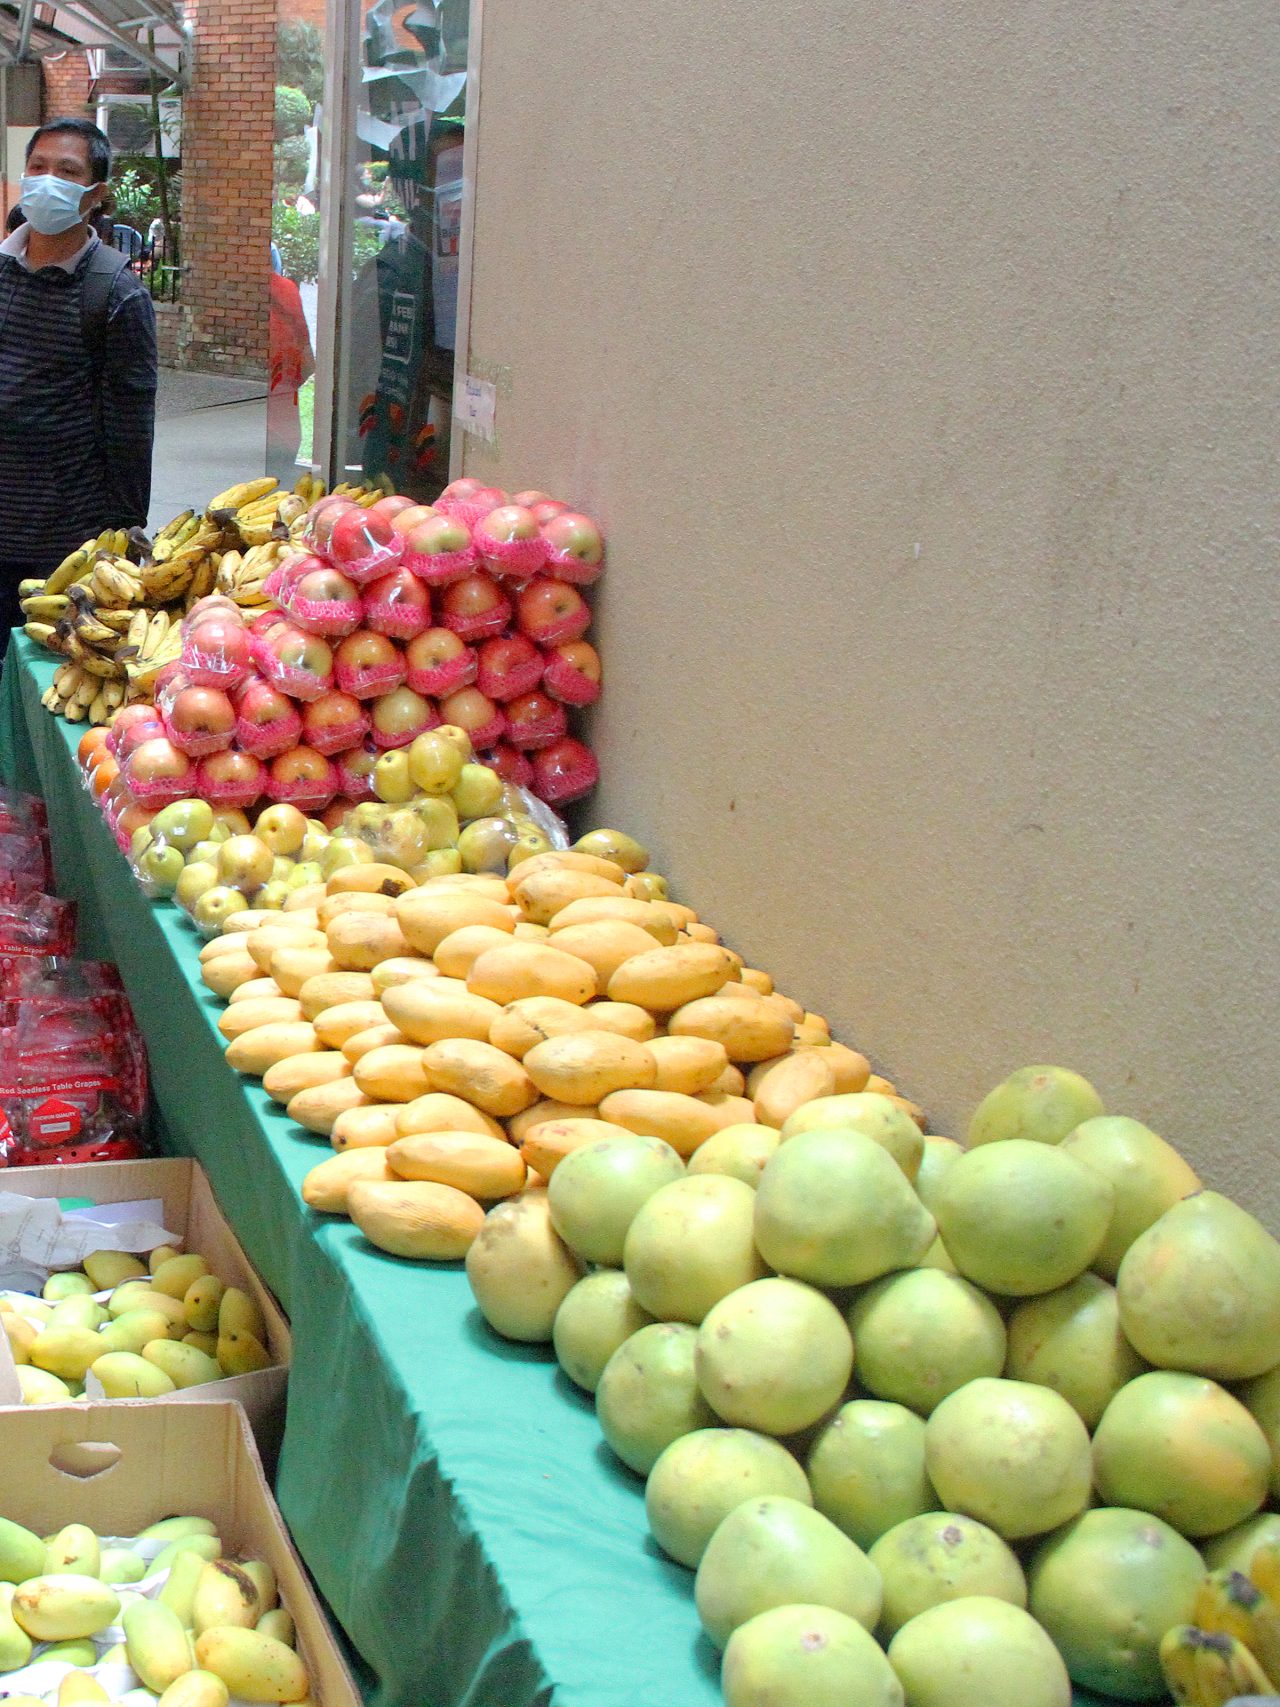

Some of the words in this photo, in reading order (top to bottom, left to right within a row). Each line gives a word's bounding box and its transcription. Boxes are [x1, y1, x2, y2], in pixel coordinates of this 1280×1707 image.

[3, 944, 22, 952] Table
[17, 1084, 51, 1094] Seedless
[52, 1081, 73, 1091] Table
[74, 1079, 101, 1089] Grapes
